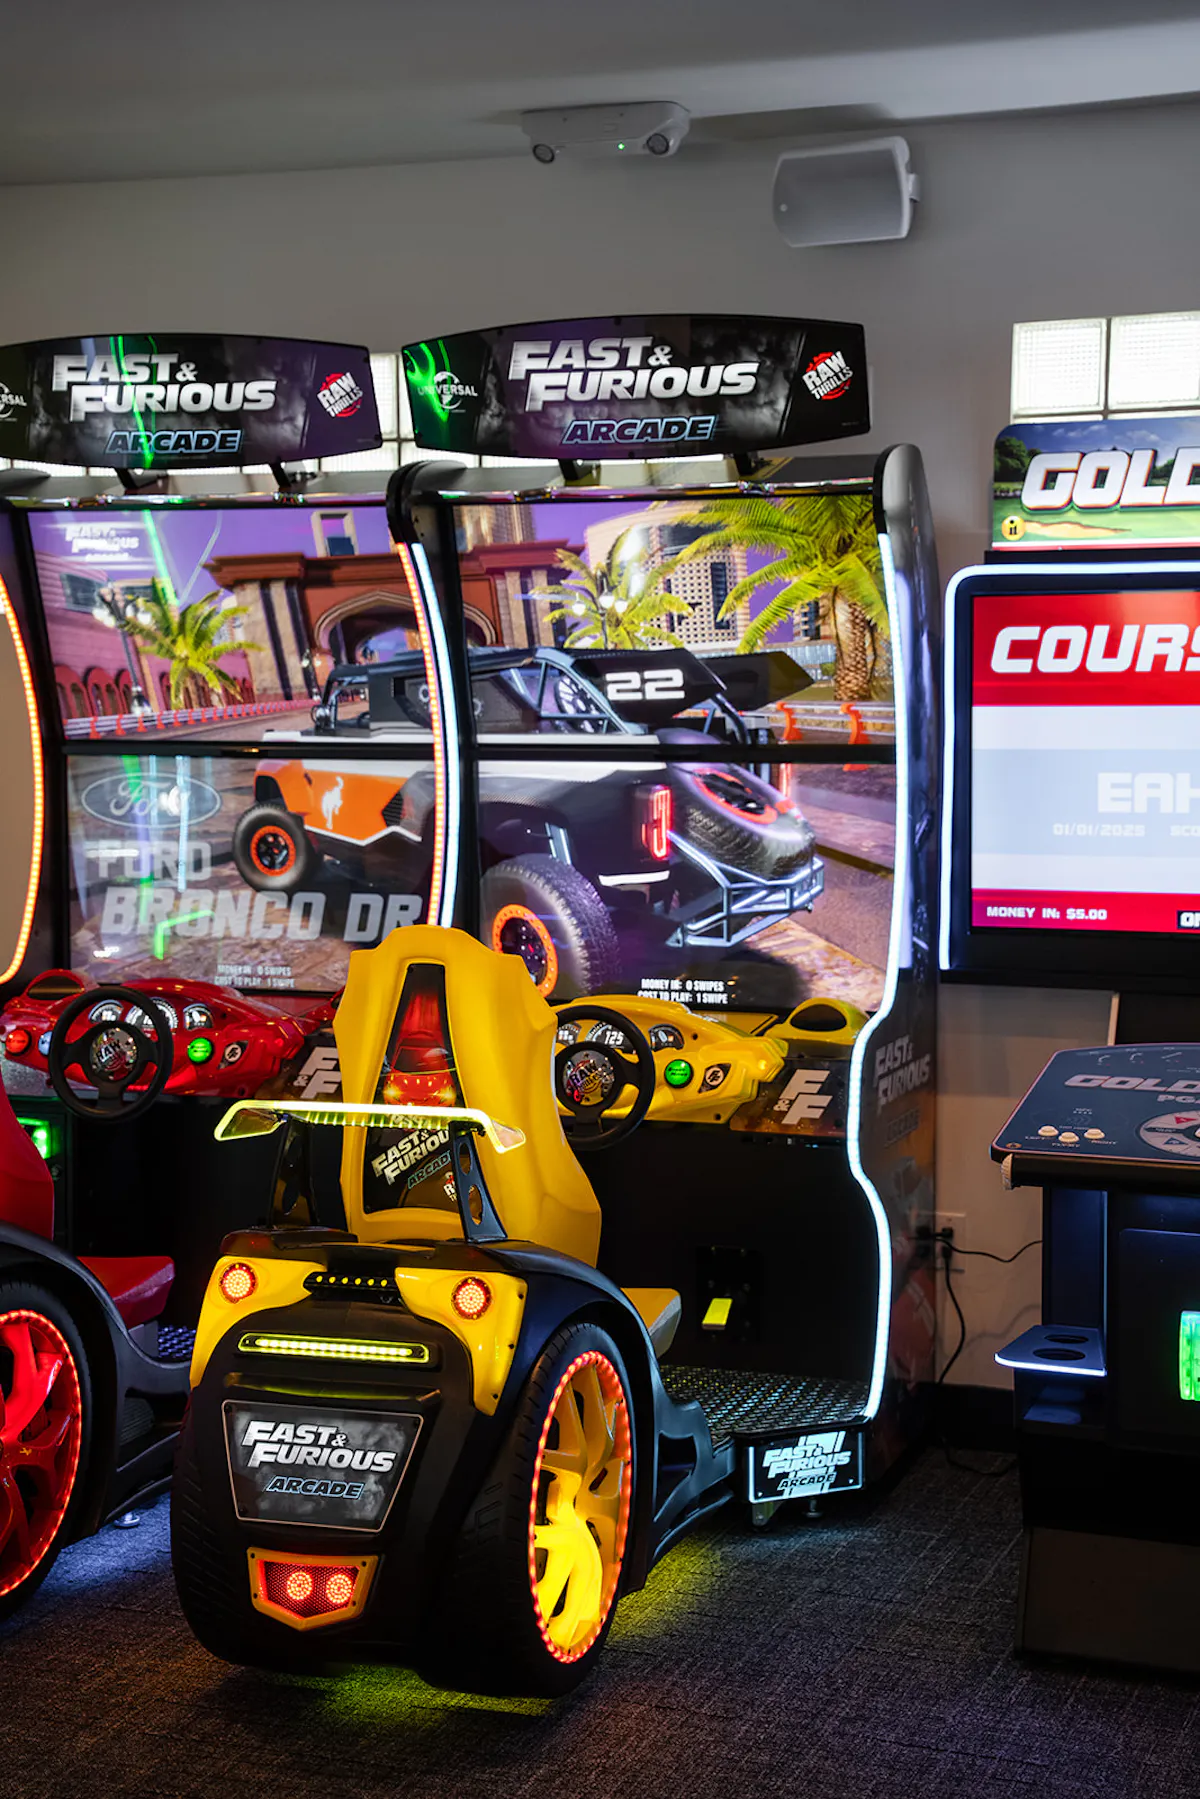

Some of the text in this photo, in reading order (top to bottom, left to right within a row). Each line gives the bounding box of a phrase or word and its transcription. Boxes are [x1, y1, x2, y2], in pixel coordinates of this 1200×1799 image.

[52, 353, 197, 391] FAST &
[508, 336, 673, 380] FAST &
[802, 351, 846, 391] RAW
[317, 372, 356, 409] RAW
[525, 362, 759, 411] FURIOUS
[811, 366, 853, 400] THRILLS
[70, 380, 277, 422] FURIOUS
[105, 429, 243, 455] ARCADE
[561, 414, 718, 445] ARCADE
[605, 669, 685, 700] 22
[1053, 823, 1145, 837] 01/01/2025
[101, 887, 326, 942] BRONCO
[987, 906, 1035, 918] MONEY
[1042, 908, 1060, 919] IN:
[1066, 909, 1108, 920] $5.00
[641, 978, 724, 992] MONEY IN: 0 SWIPES
[670, 992, 692, 1002] PLAY:
[696, 993, 701, 1003] 1
[702, 993, 728, 1004] SWIPE
[604, 1031, 624, 1045] 125
[873, 1034, 909, 1088] FAST
[876, 1053, 931, 1116] FURIOUS
[773, 1100, 790, 1111] &
[371, 1130, 422, 1177] FAST
[383, 1129, 450, 1186] FURIOU
[408, 1150, 451, 1189] ARCAD
[241, 1420, 347, 1448] FAST &
[247, 1443, 397, 1473] FURIOUS
[762, 1445, 818, 1467] FAST
[767, 1450, 852, 1479] FURIOUS
[266, 1475, 364, 1500] ARCADE
[777, 1471, 837, 1491] ARCADE
